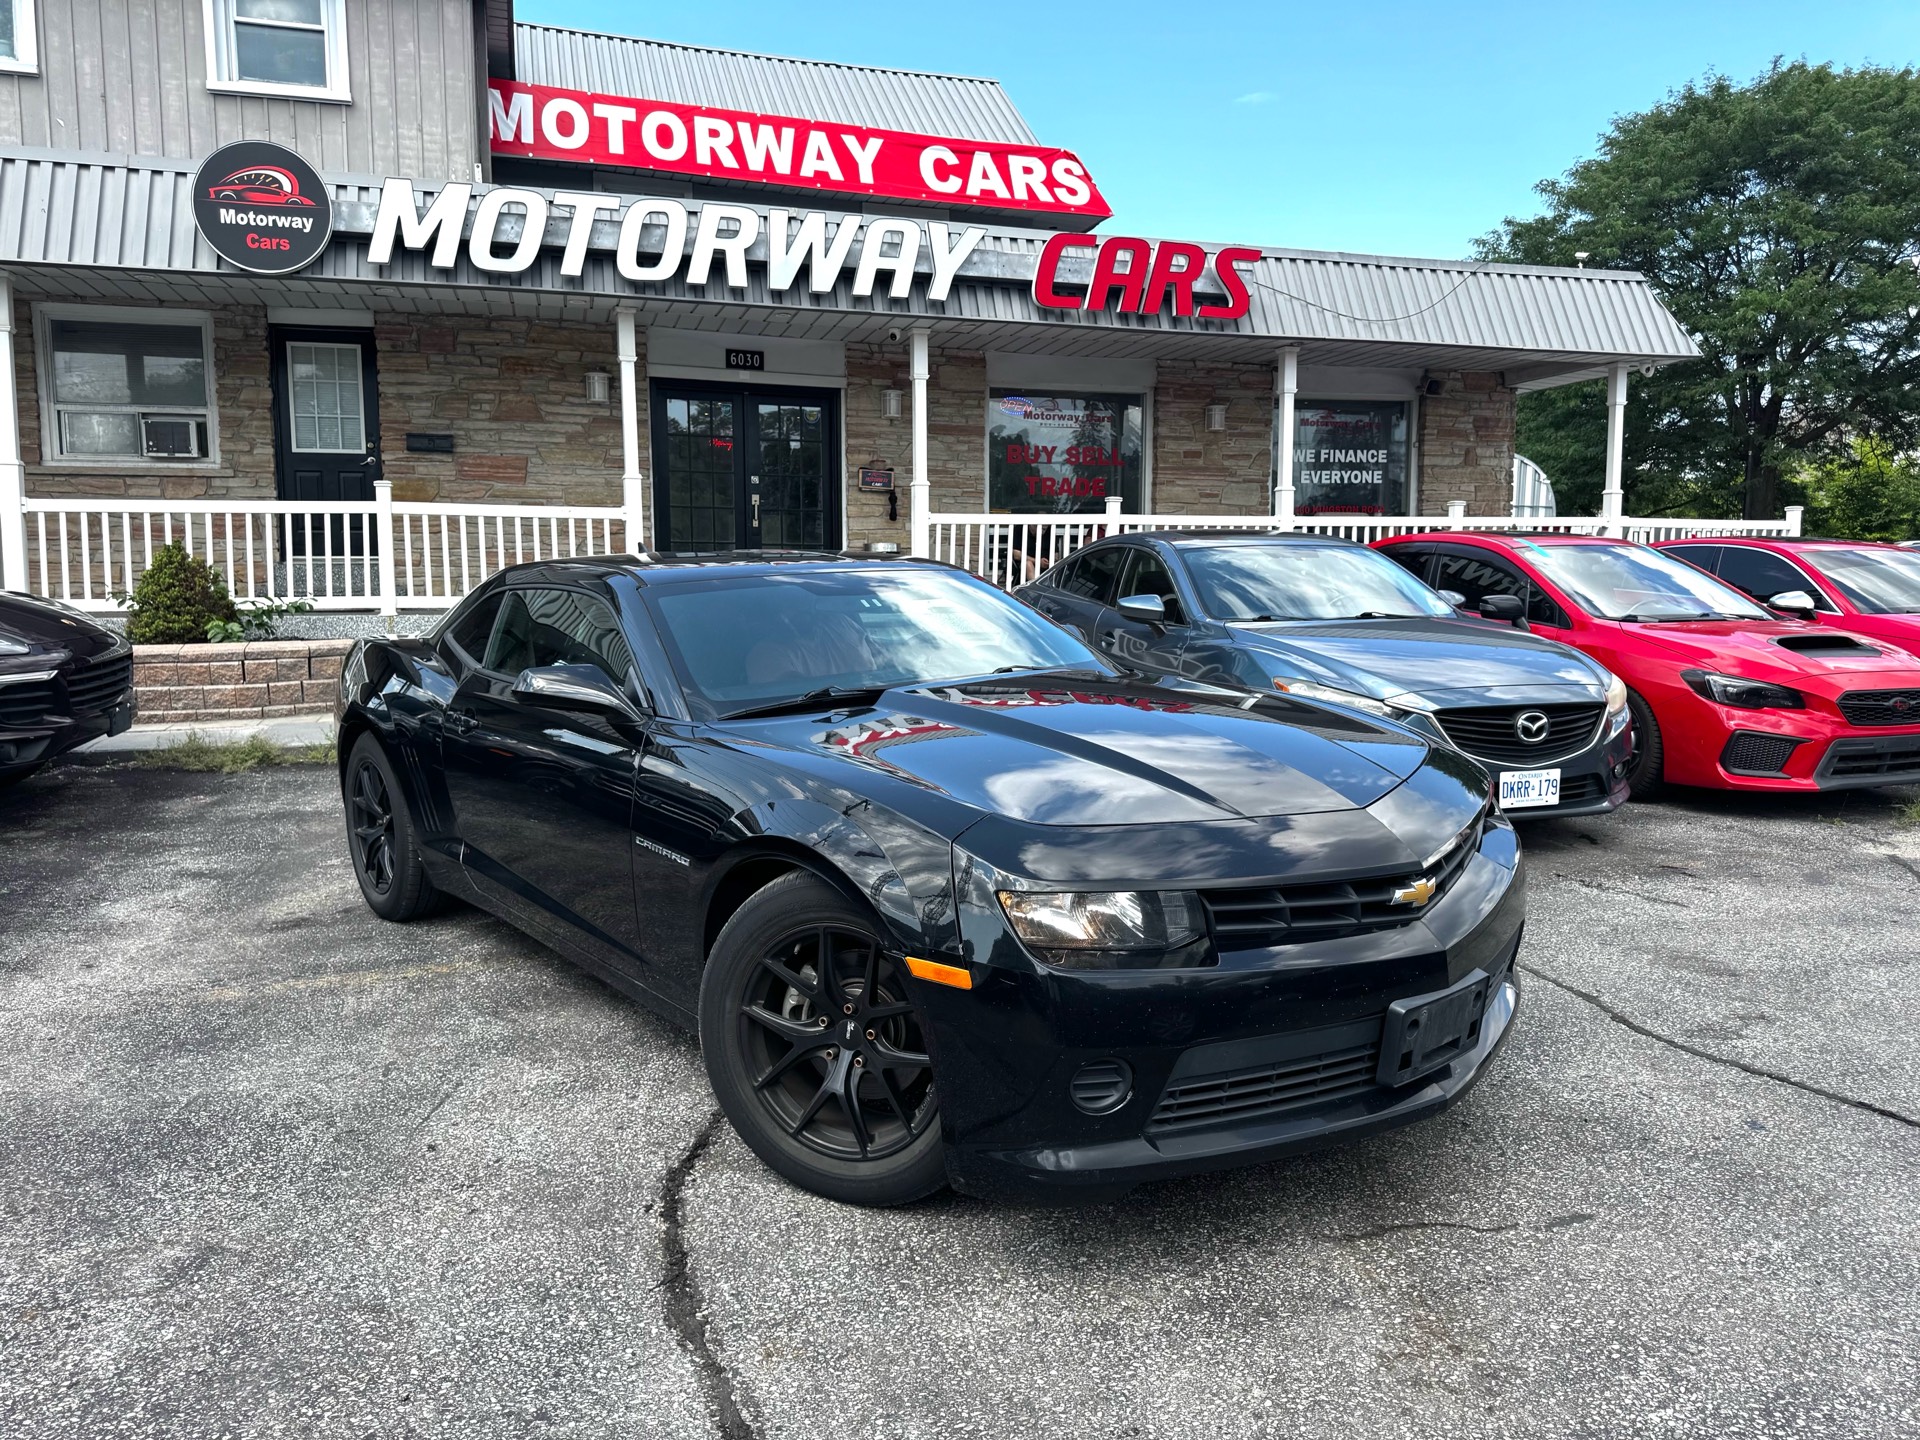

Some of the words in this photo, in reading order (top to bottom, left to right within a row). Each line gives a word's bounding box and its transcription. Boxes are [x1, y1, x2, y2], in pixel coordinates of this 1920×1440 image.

[489, 88, 884, 185] MOTORWAY
[919, 145, 1091, 206] CARS
[219, 208, 314, 233] Motorway
[246, 233, 290, 251] Cars
[367, 177, 988, 301] MOTORWAY
[1031, 233, 1263, 319] CARS
[730, 352, 760, 367] 6030
[1000, 399, 1033, 413] OPEN
[1023, 411, 1081, 424] Motorway
[1006, 444, 1058, 464] BUY
[1065, 446, 1126, 467] SELL
[1293, 449, 1316, 463] WE
[1320, 449, 1388, 463] FINANCE
[1024, 476, 1106, 496] TRADE
[1300, 470, 1383, 484] EVERYONE
[635, 836, 690, 867] CAMARO
